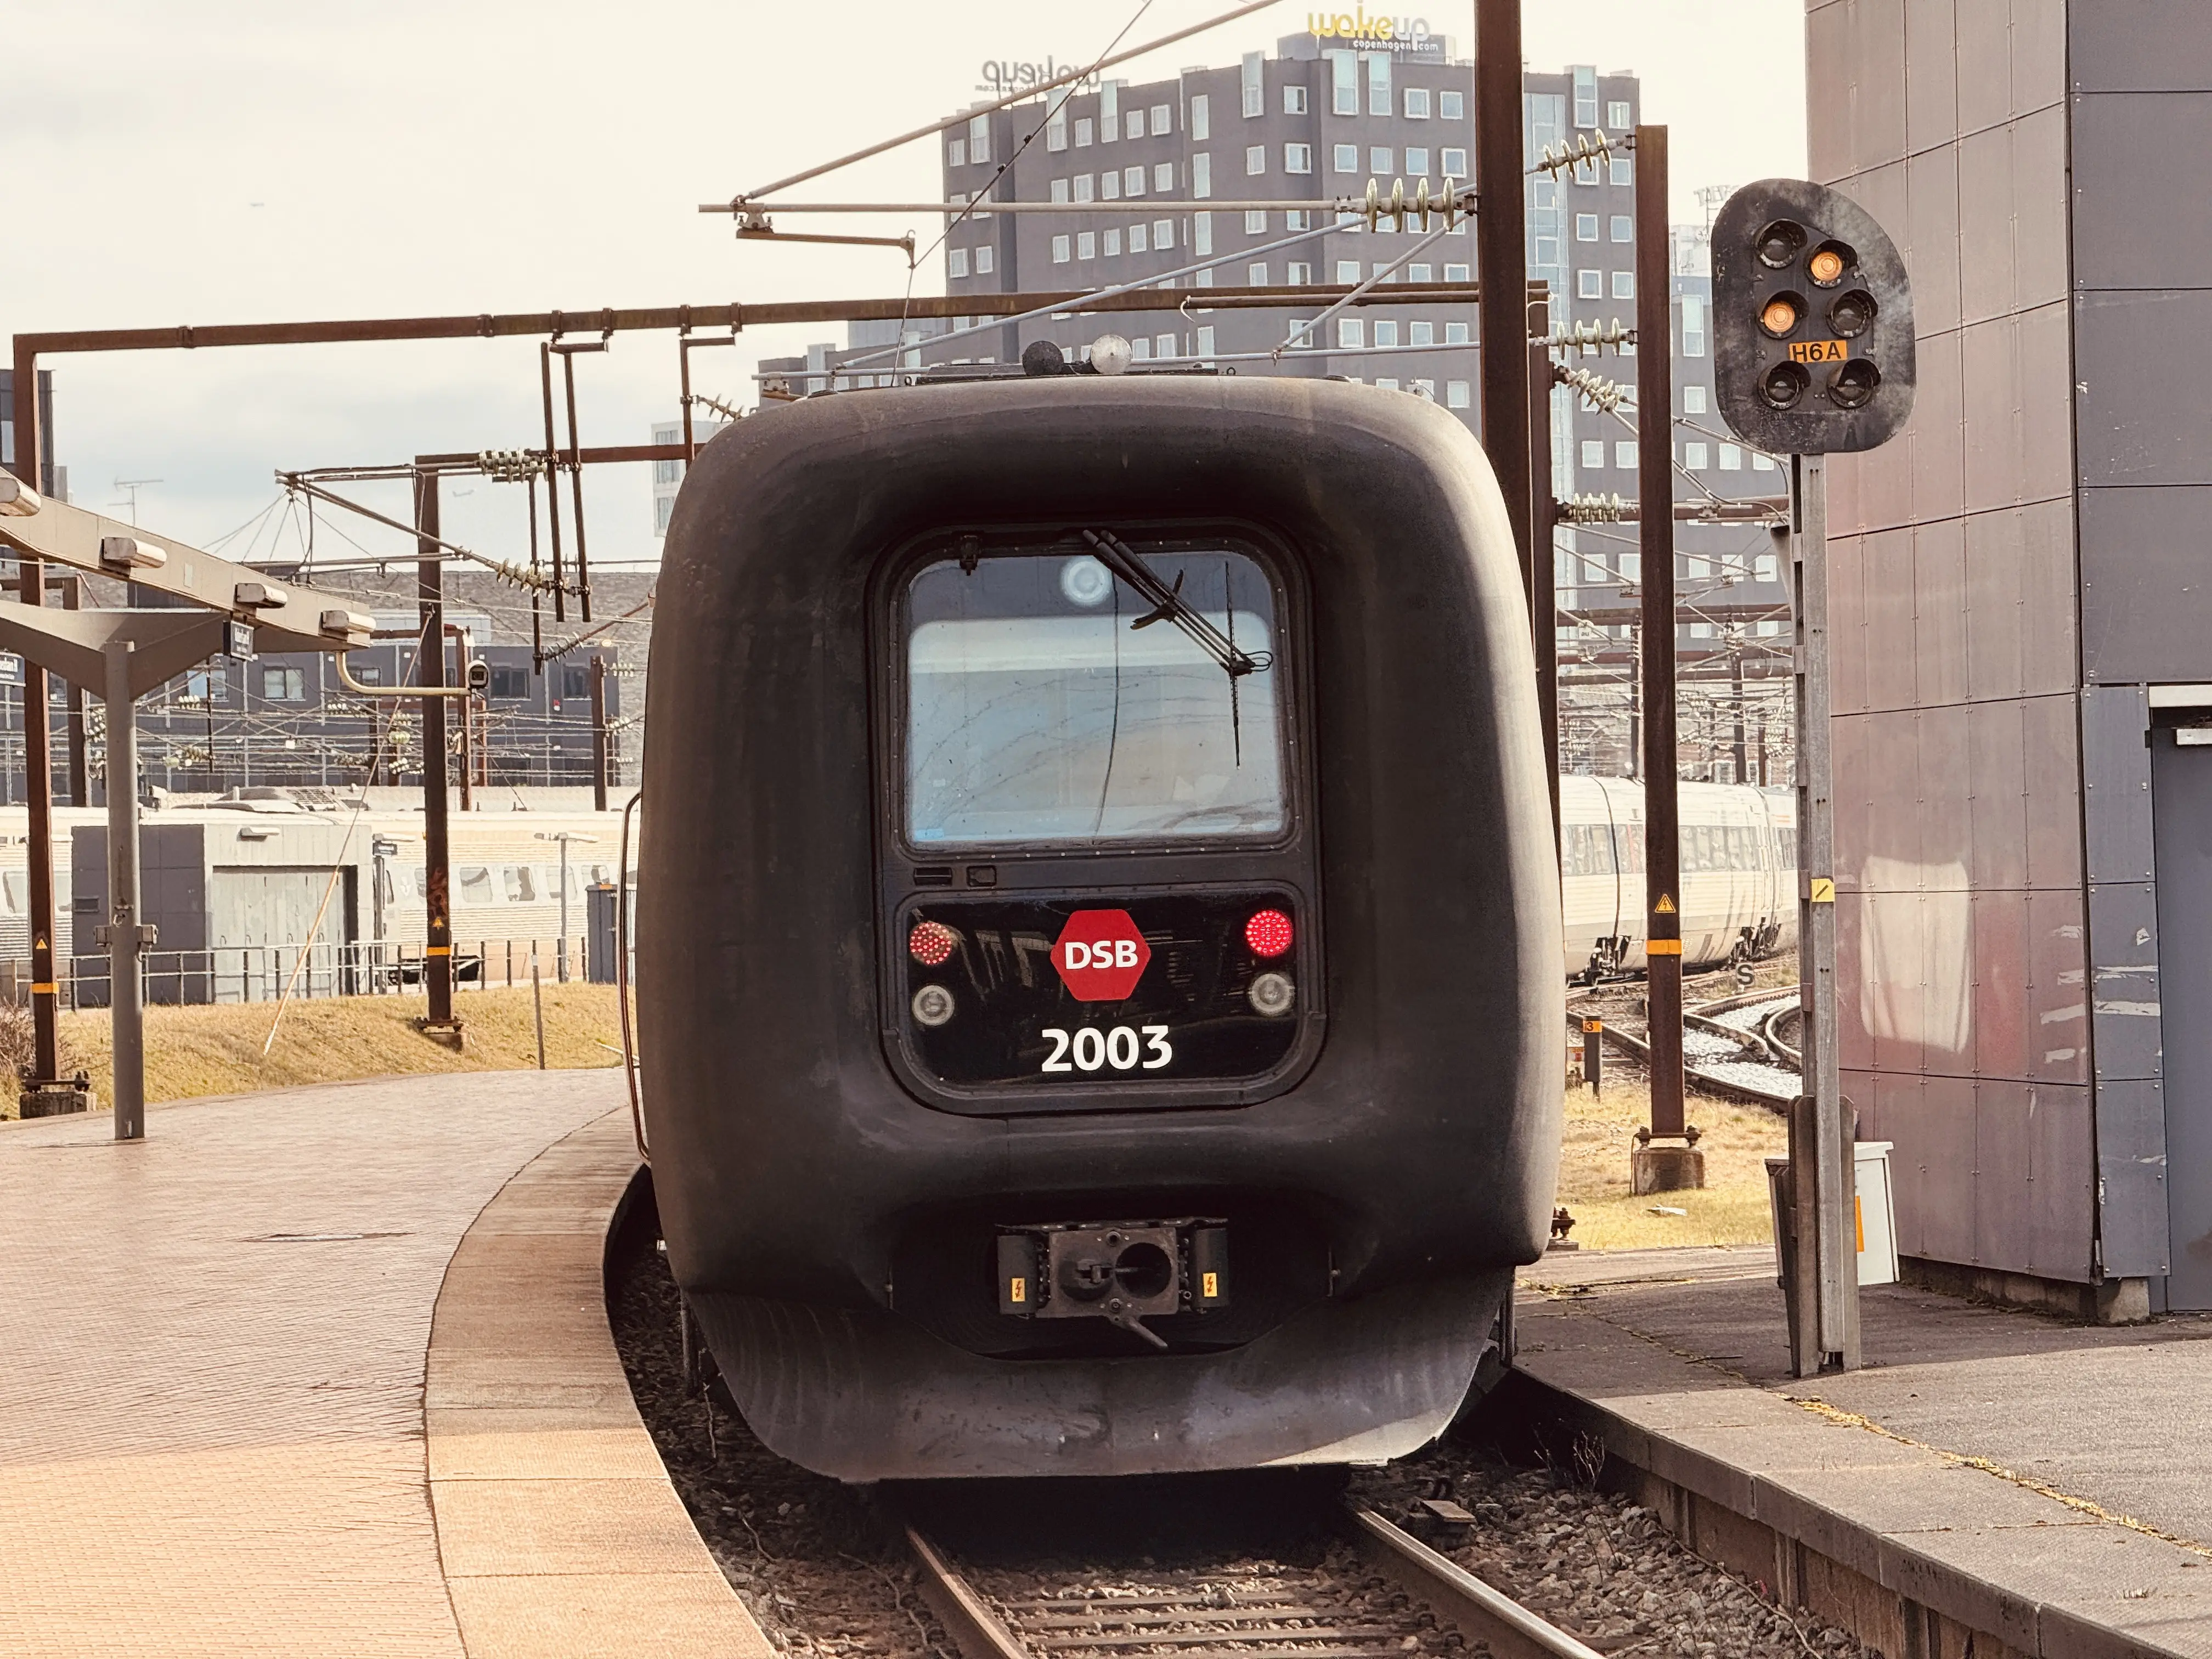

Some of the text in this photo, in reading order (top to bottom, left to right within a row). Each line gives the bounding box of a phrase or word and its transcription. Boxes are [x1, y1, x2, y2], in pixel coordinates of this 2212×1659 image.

[1307, 5, 1430, 50] wakeup
[1792, 342, 1841, 362] H6A
[1065, 940, 1138, 969] DSB
[1737, 964, 1753, 985] S
[1041, 1025, 1172, 1072] 2003
